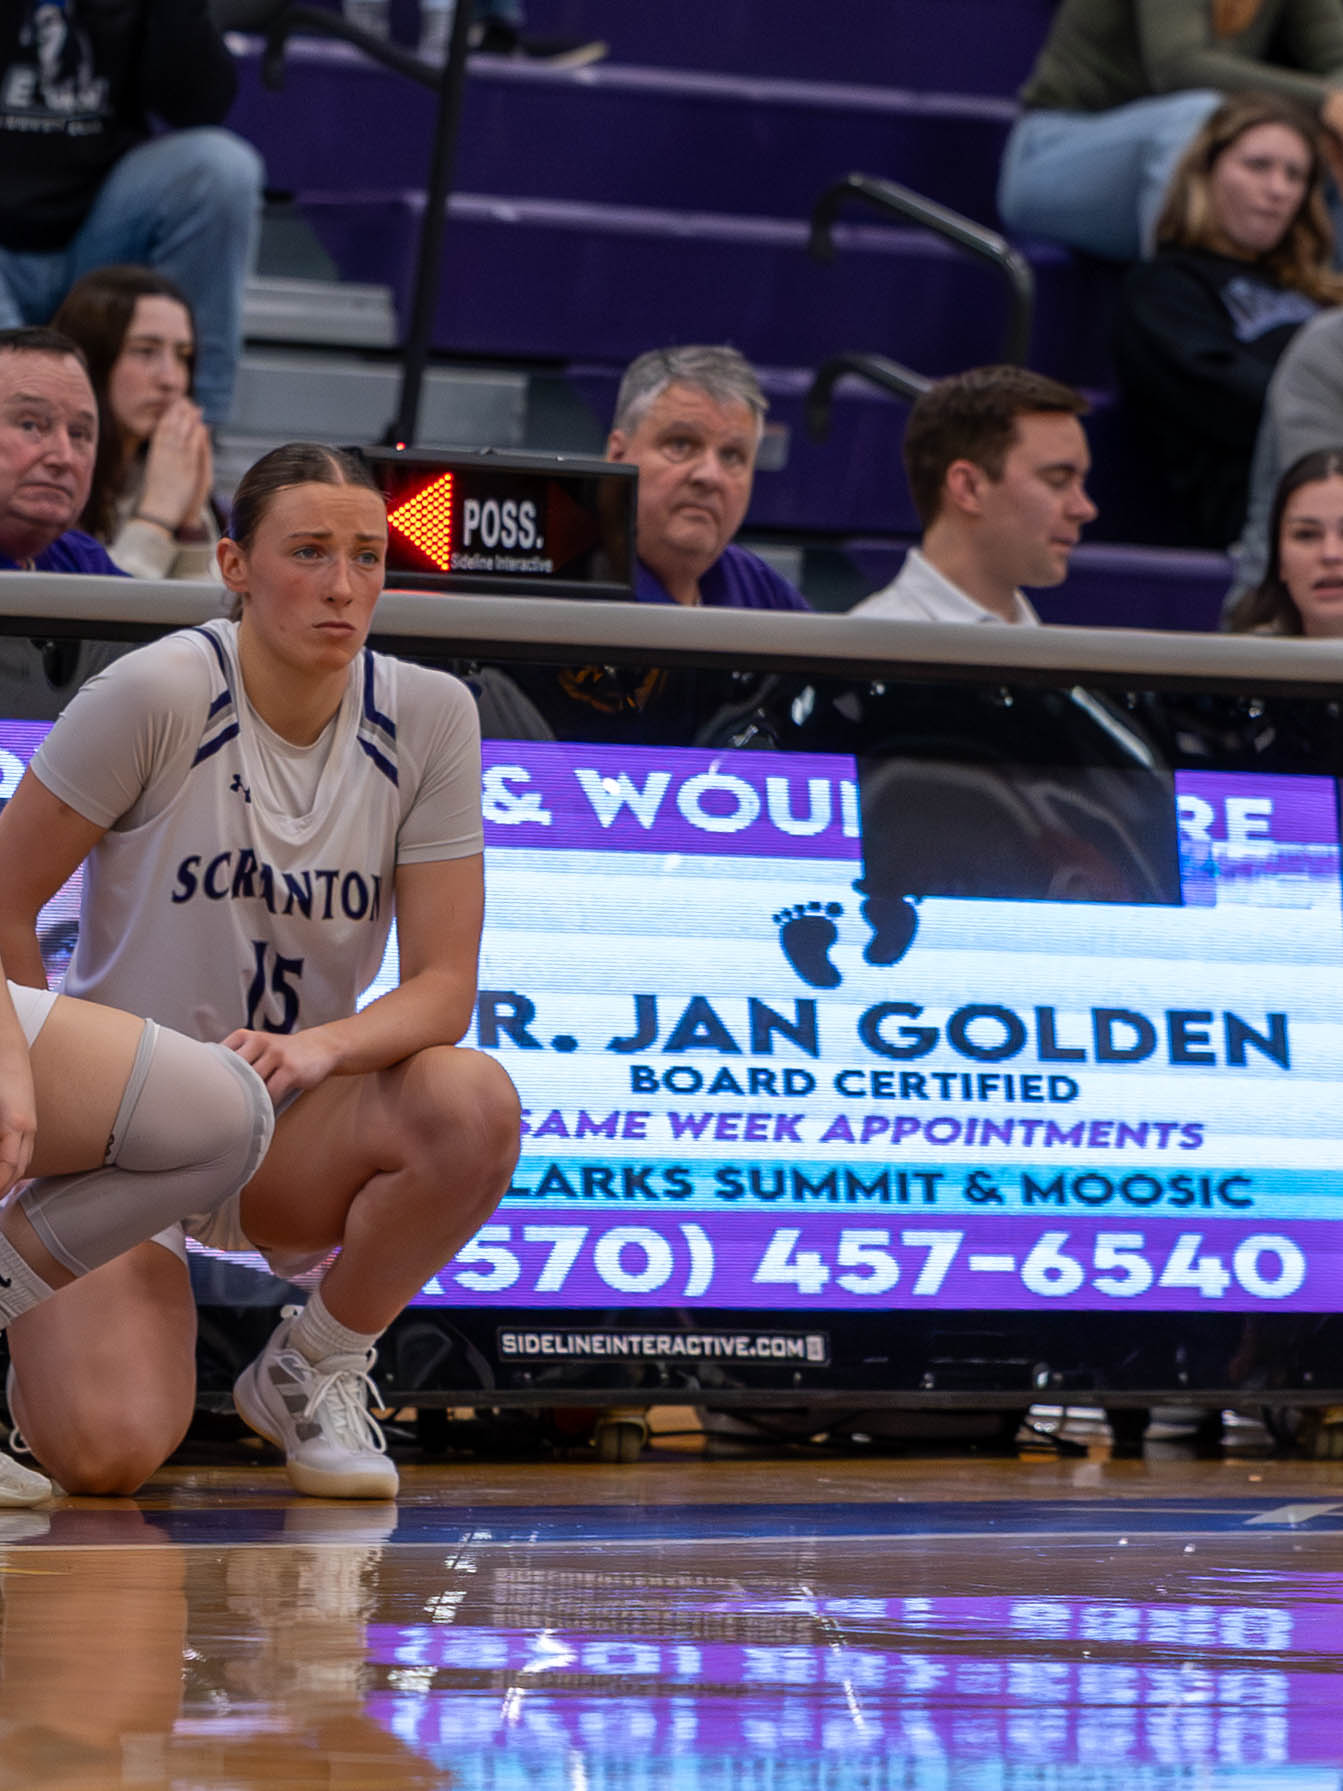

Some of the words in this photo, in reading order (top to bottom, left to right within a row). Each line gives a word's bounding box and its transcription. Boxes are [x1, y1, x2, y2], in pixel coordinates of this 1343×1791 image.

[463, 499, 544, 549] POSS.
[451, 552, 493, 571] Sideline
[481, 765, 552, 826] &
[1176, 795, 1274, 858] RE
[246, 939, 304, 1035] 15
[477, 990, 579, 1053] R.
[606, 993, 820, 1059] JAN
[857, 1001, 1291, 1071] GOLDEN
[630, 1065, 817, 1097] BOARD
[833, 1070, 1080, 1104] CERTIFIED
[668, 1111, 805, 1143] WEEK
[818, 1114, 1205, 1151] APPOINTMENTS
[505, 1163, 693, 1201] LARKS
[714, 1167, 944, 1205] SUMMIT
[963, 1170, 1005, 1206] &
[1020, 1172, 1254, 1209] MOOSIC
[422, 1223, 715, 1297] 570)
[752, 1227, 1306, 1300] 457-6540
[501, 1333, 804, 1359] SIDELINEINTERACTIVE.COM
